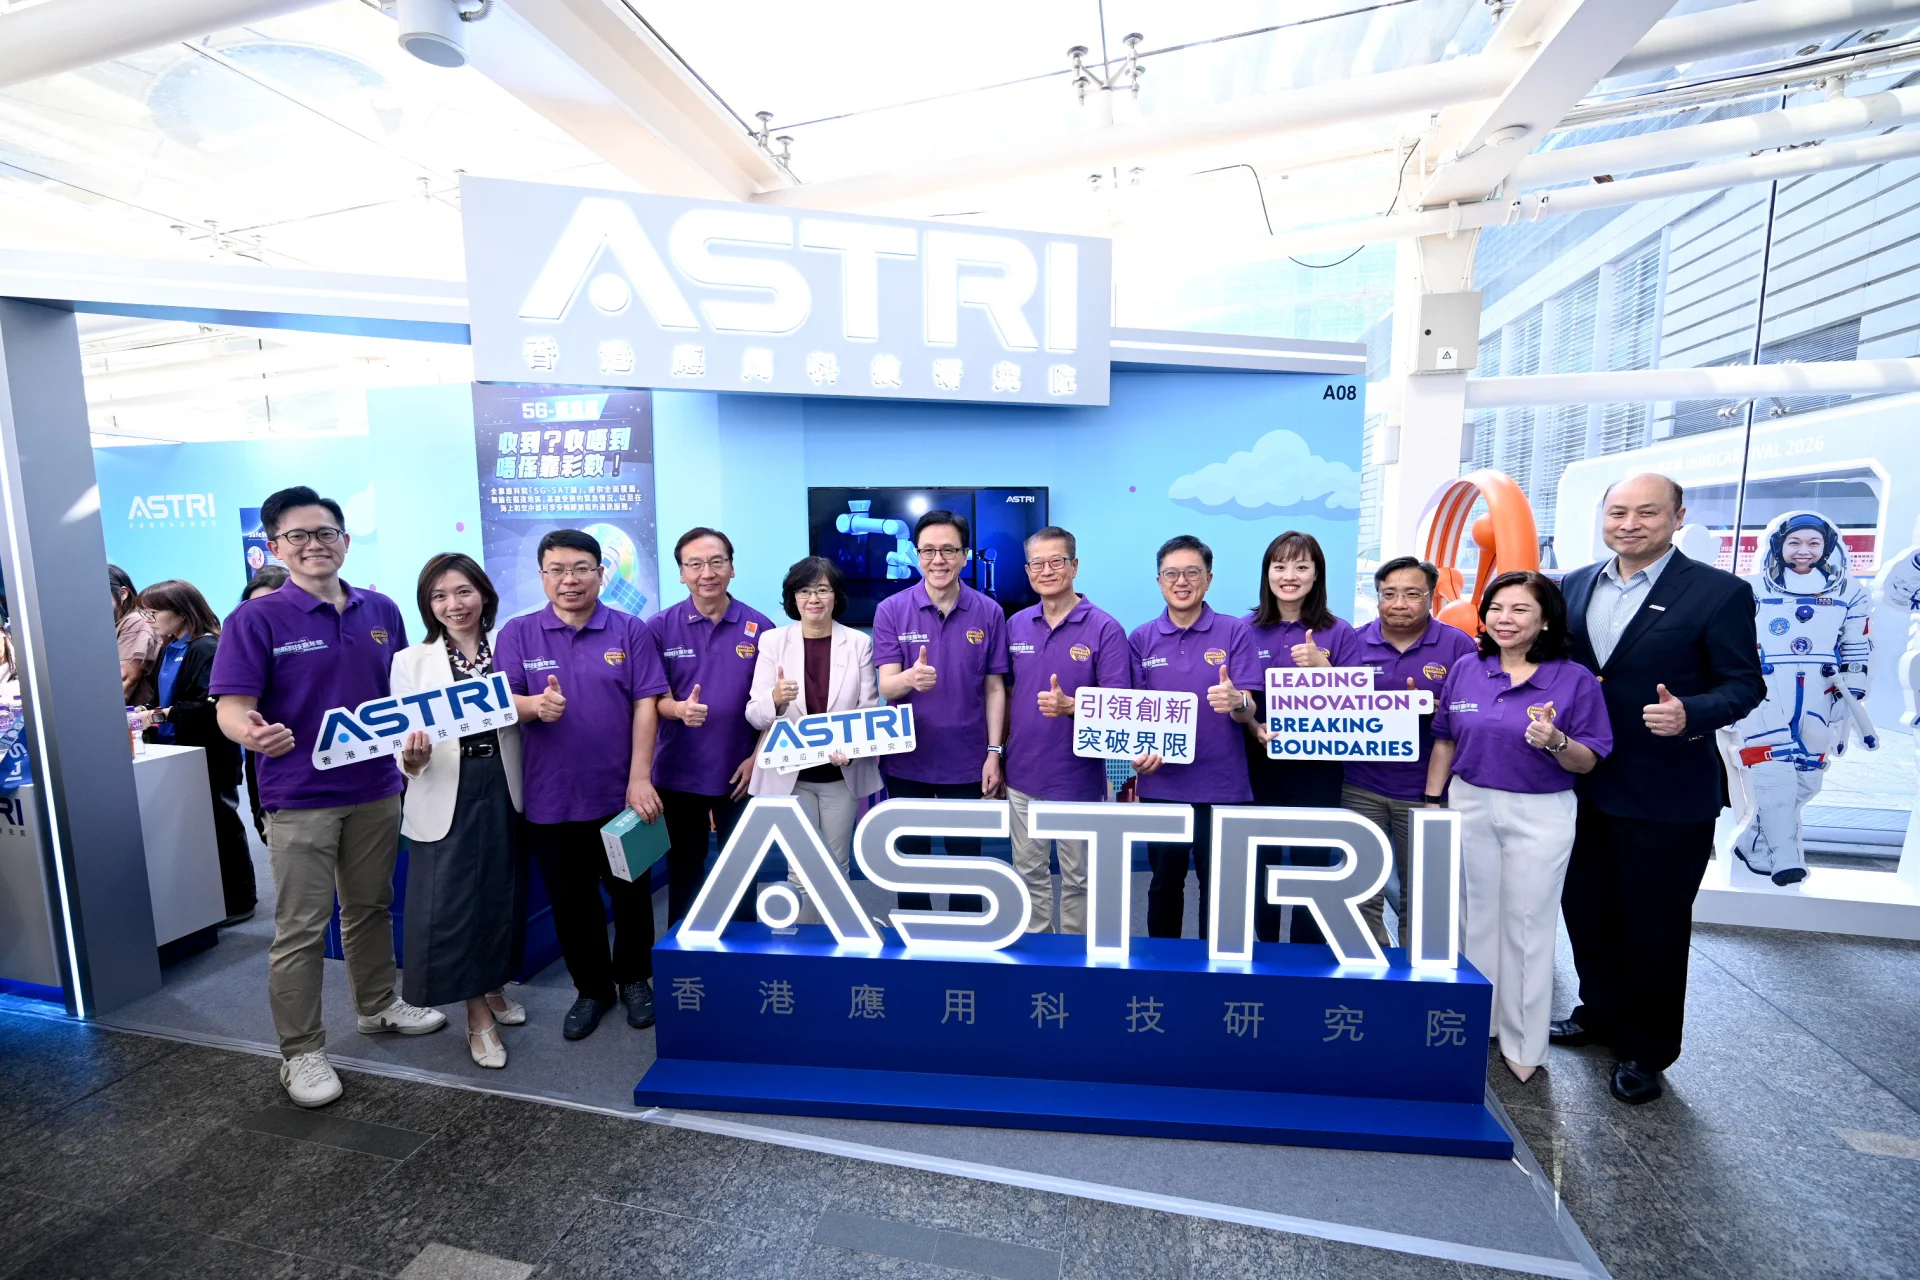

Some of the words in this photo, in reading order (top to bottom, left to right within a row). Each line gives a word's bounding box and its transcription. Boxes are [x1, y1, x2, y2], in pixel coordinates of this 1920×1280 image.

[519, 197, 1079, 353] ASTRI
[1323, 385, 1357, 401] A08
[1686, 442, 1782, 471] INNOCARIVAL
[1786, 436, 1824, 455] 2026
[128, 493, 216, 520] ASTRI
[1271, 672, 1368, 688] LEADING
[318, 676, 510, 752] ASTRI
[1081, 694, 1191, 724] 引領創新
[1271, 694, 1410, 711] INNOVATION
[321, 712, 514, 766] 香港應用技研究院
[763, 707, 911, 752] ASTRI
[1270, 717, 1383, 733] BREAKING
[1077, 727, 1187, 758] 突破界限
[1271, 739, 1413, 756] BOUNDARIES
[677, 795, 1461, 969] ASTRI
[671, 976, 1467, 1047] 香港應用科技研究院
